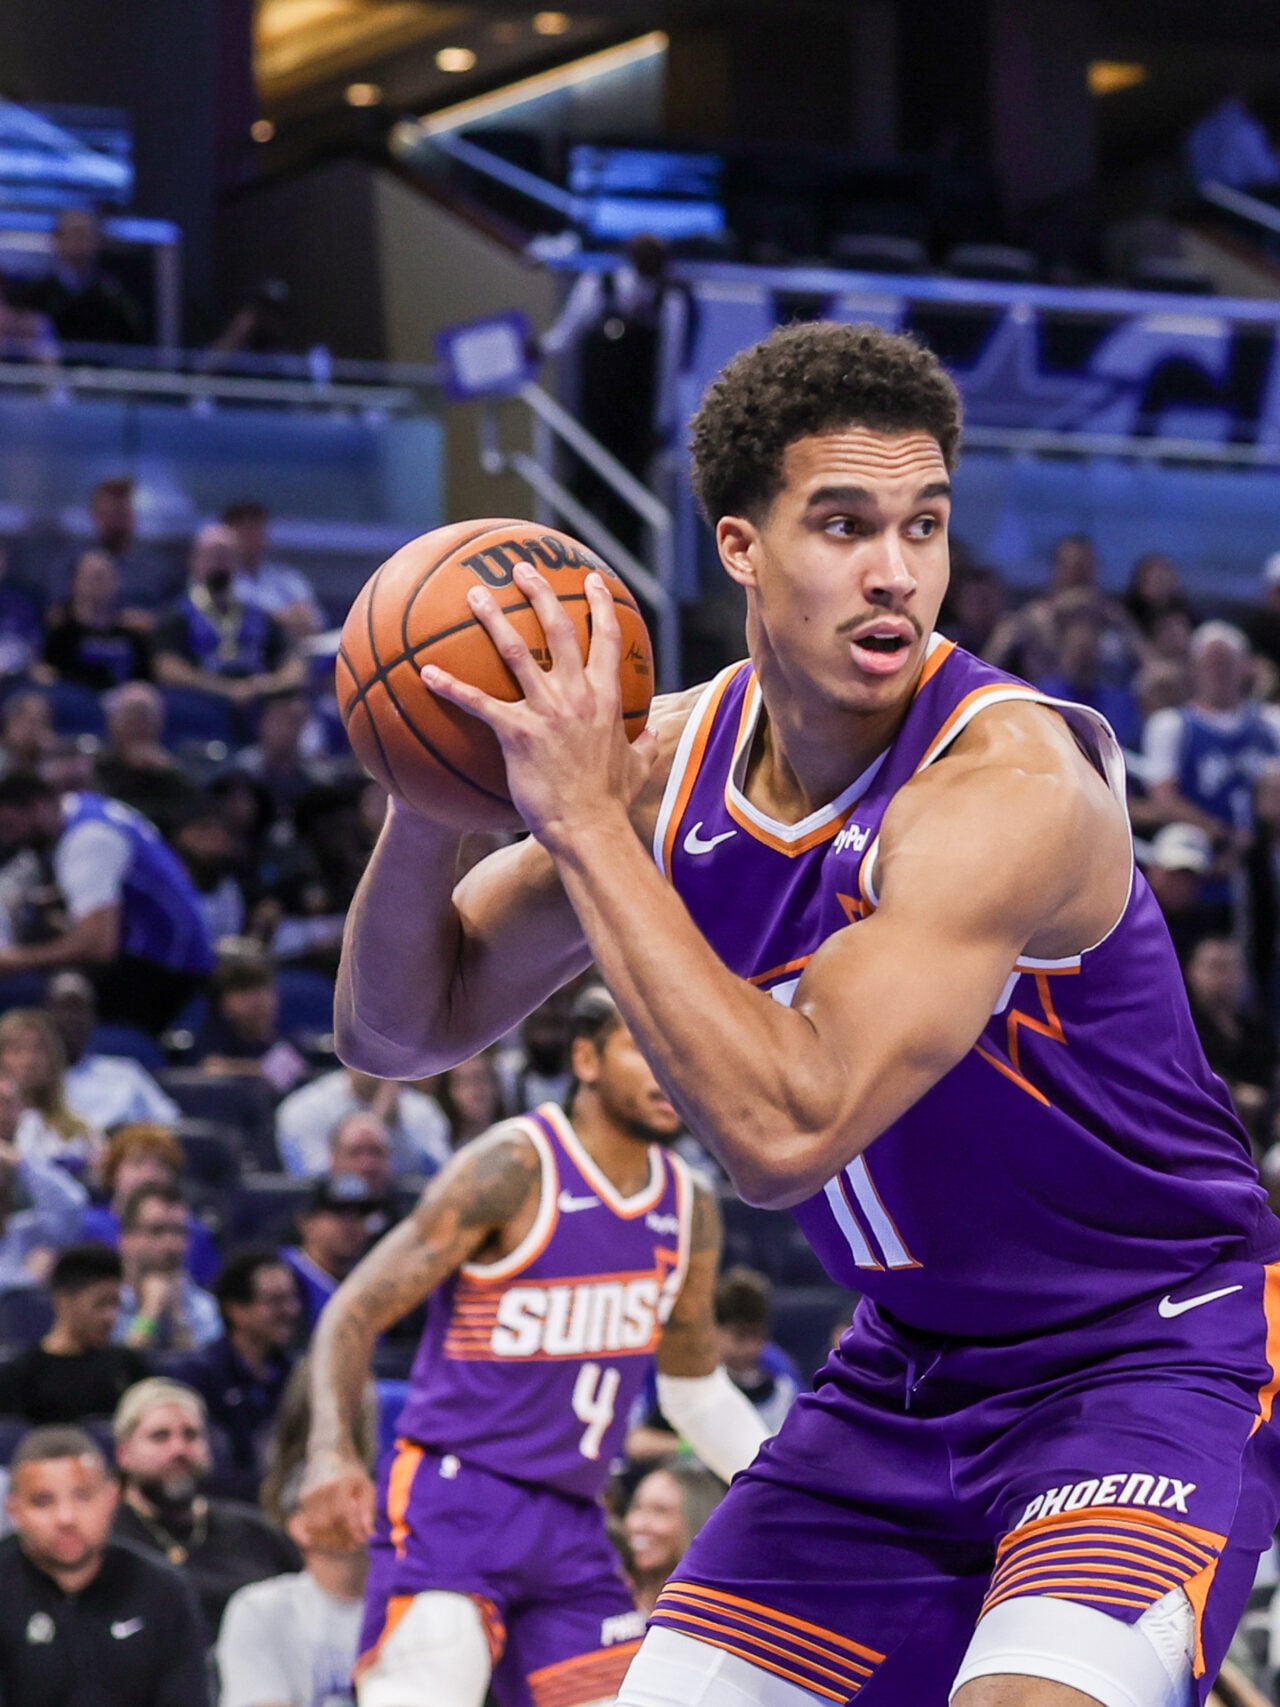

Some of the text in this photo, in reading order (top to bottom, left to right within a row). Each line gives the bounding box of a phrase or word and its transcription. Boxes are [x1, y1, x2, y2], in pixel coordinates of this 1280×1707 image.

[490, 1278, 660, 1357] SUNS
[572, 1361, 621, 1460] 4
[1016, 1473, 1196, 1531] PHOENIX
